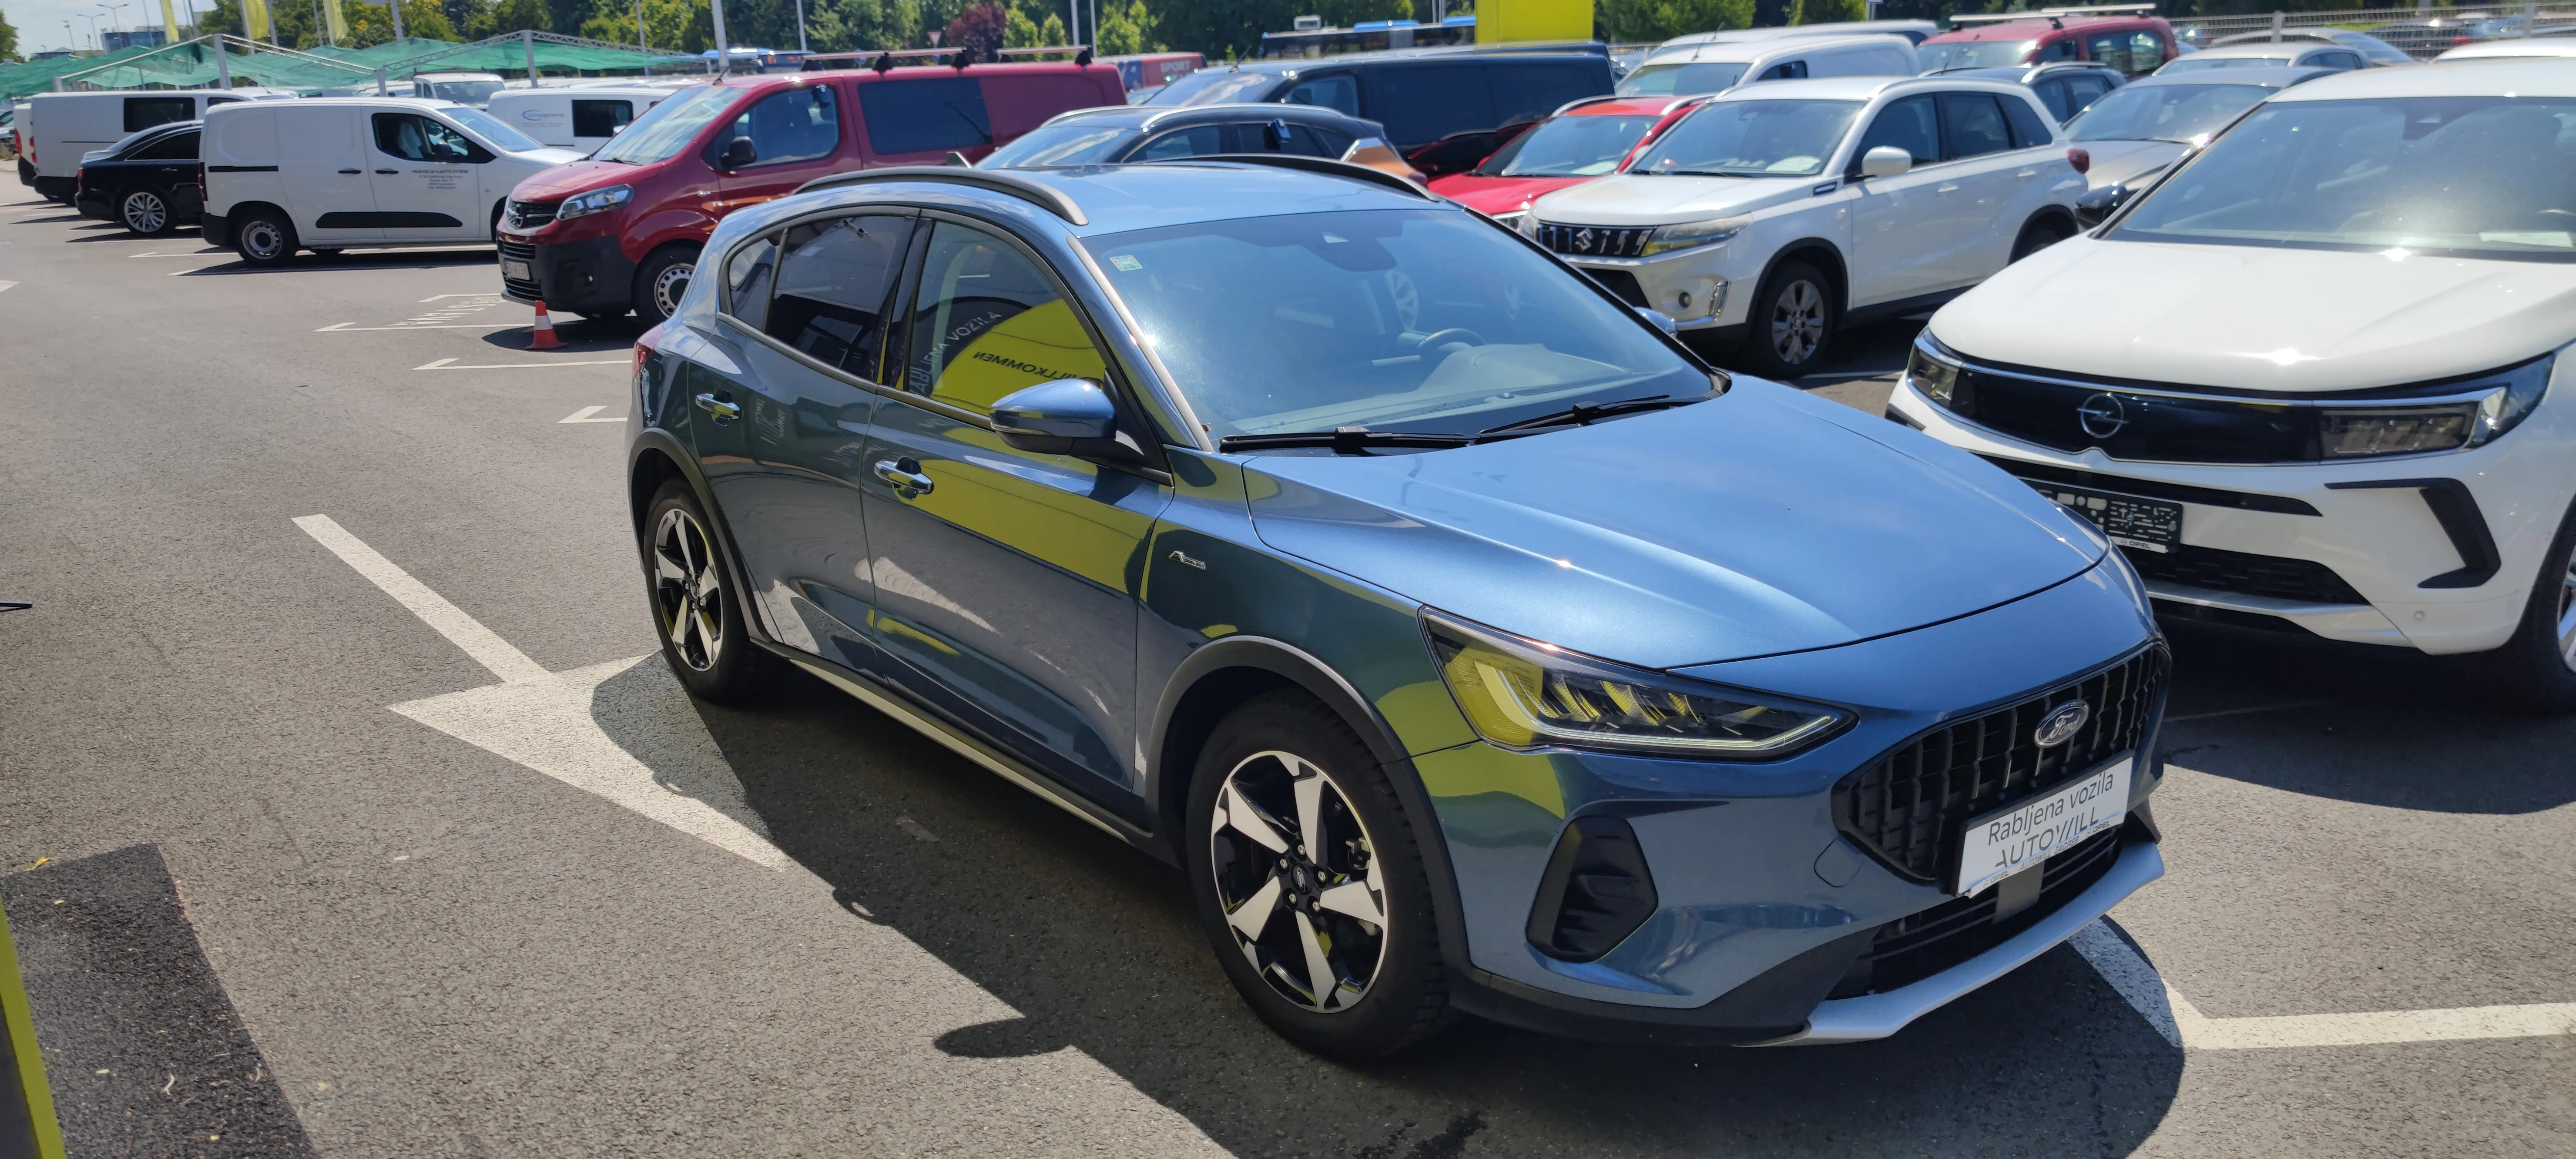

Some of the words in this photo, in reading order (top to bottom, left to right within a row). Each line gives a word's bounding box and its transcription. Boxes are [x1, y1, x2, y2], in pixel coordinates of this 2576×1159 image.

[1160, 61, 1191, 73] SPORT
[2129, 541, 2150, 549] OPEL
[2050, 712, 2080, 739] Ford
[1988, 798, 2064, 847] Rabljena
[2070, 771, 2113, 809] vozila
[2092, 821, 2111, 834] OPEL
[2019, 851, 2052, 871] AUTOWILL
[2054, 835, 2080, 855] ZAGREB
[1990, 870, 2009, 884] OPEL
